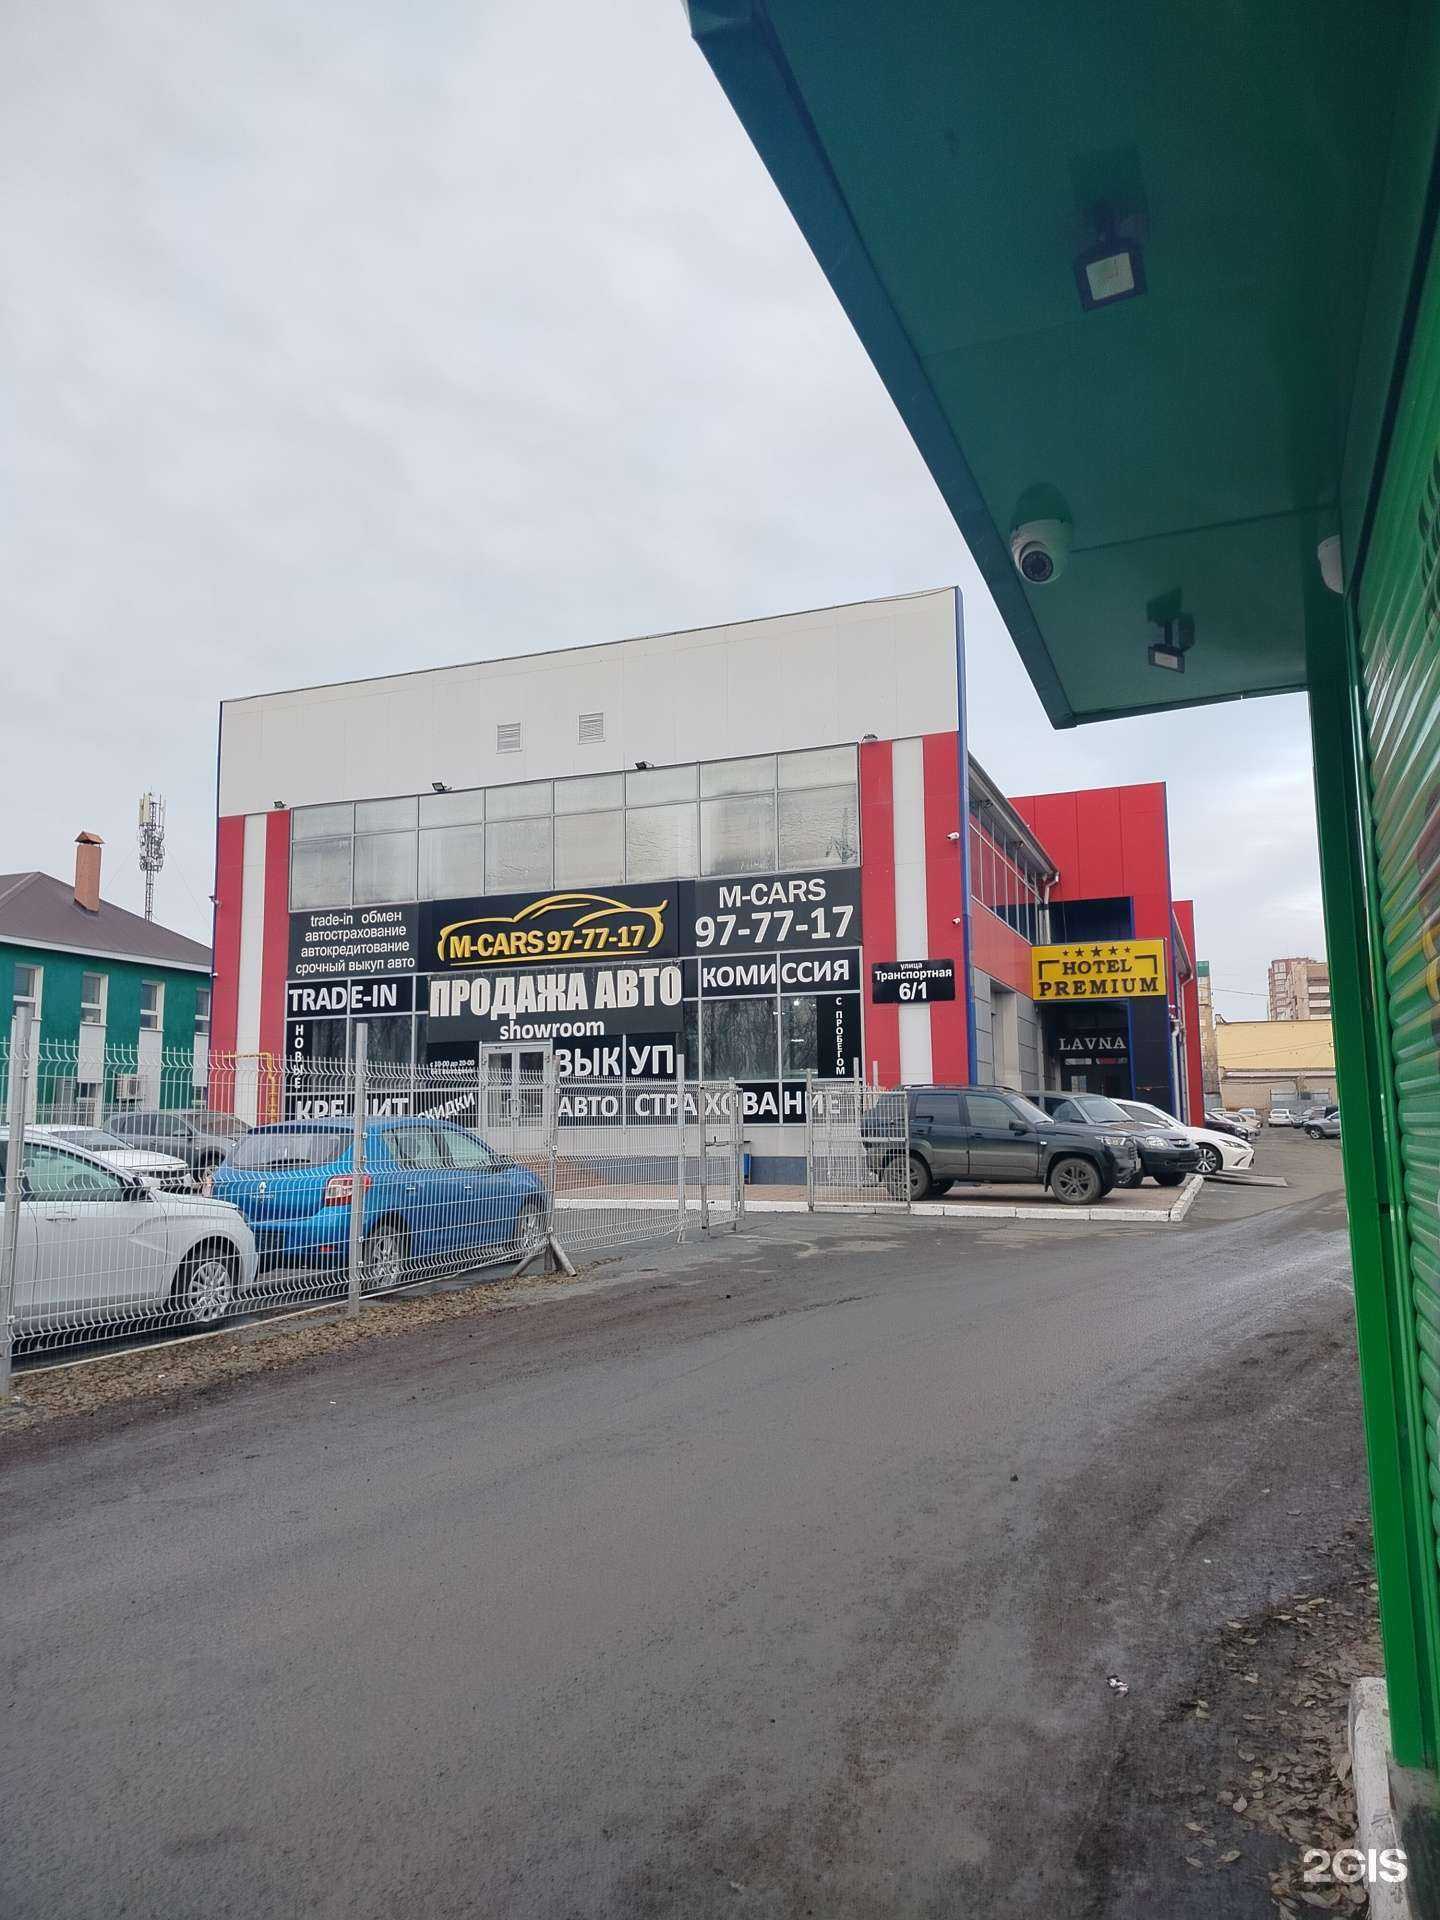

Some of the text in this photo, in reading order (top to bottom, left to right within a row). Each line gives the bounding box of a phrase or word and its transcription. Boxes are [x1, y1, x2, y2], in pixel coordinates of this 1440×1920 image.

[719, 878, 827, 909] M-CARS
[310, 910, 402, 927] trade-in обмен
[695, 905, 854, 948] 97-77-17
[305, 925, 407, 942] автострахование
[450, 925, 646, 959] M-CARS 97-77-17
[301, 941, 410, 958] автокредитование
[295, 957, 415, 976] срочный выкуп авто
[703, 959, 850, 988] КОМИССИЯ
[875, 969, 952, 982] Транспортная
[900, 962, 922, 970] улица
[1062, 959, 1132, 975] HOTEL
[430, 966, 682, 1020] ПРОДАЖА АВТО
[899, 981, 927, 1000] 6/1
[1039, 977, 1159, 997] PREMIUM
[289, 983, 397, 1012] TRADE-IN
[500, 1020, 605, 1040] showroom
[836, 1011, 845, 1075] ПРОБЕГОМ
[1059, 1036, 1127, 1051] LAVNA
[296, 1098, 409, 1120] КРЕИТ
[558, 1096, 619, 1117] АВТО
